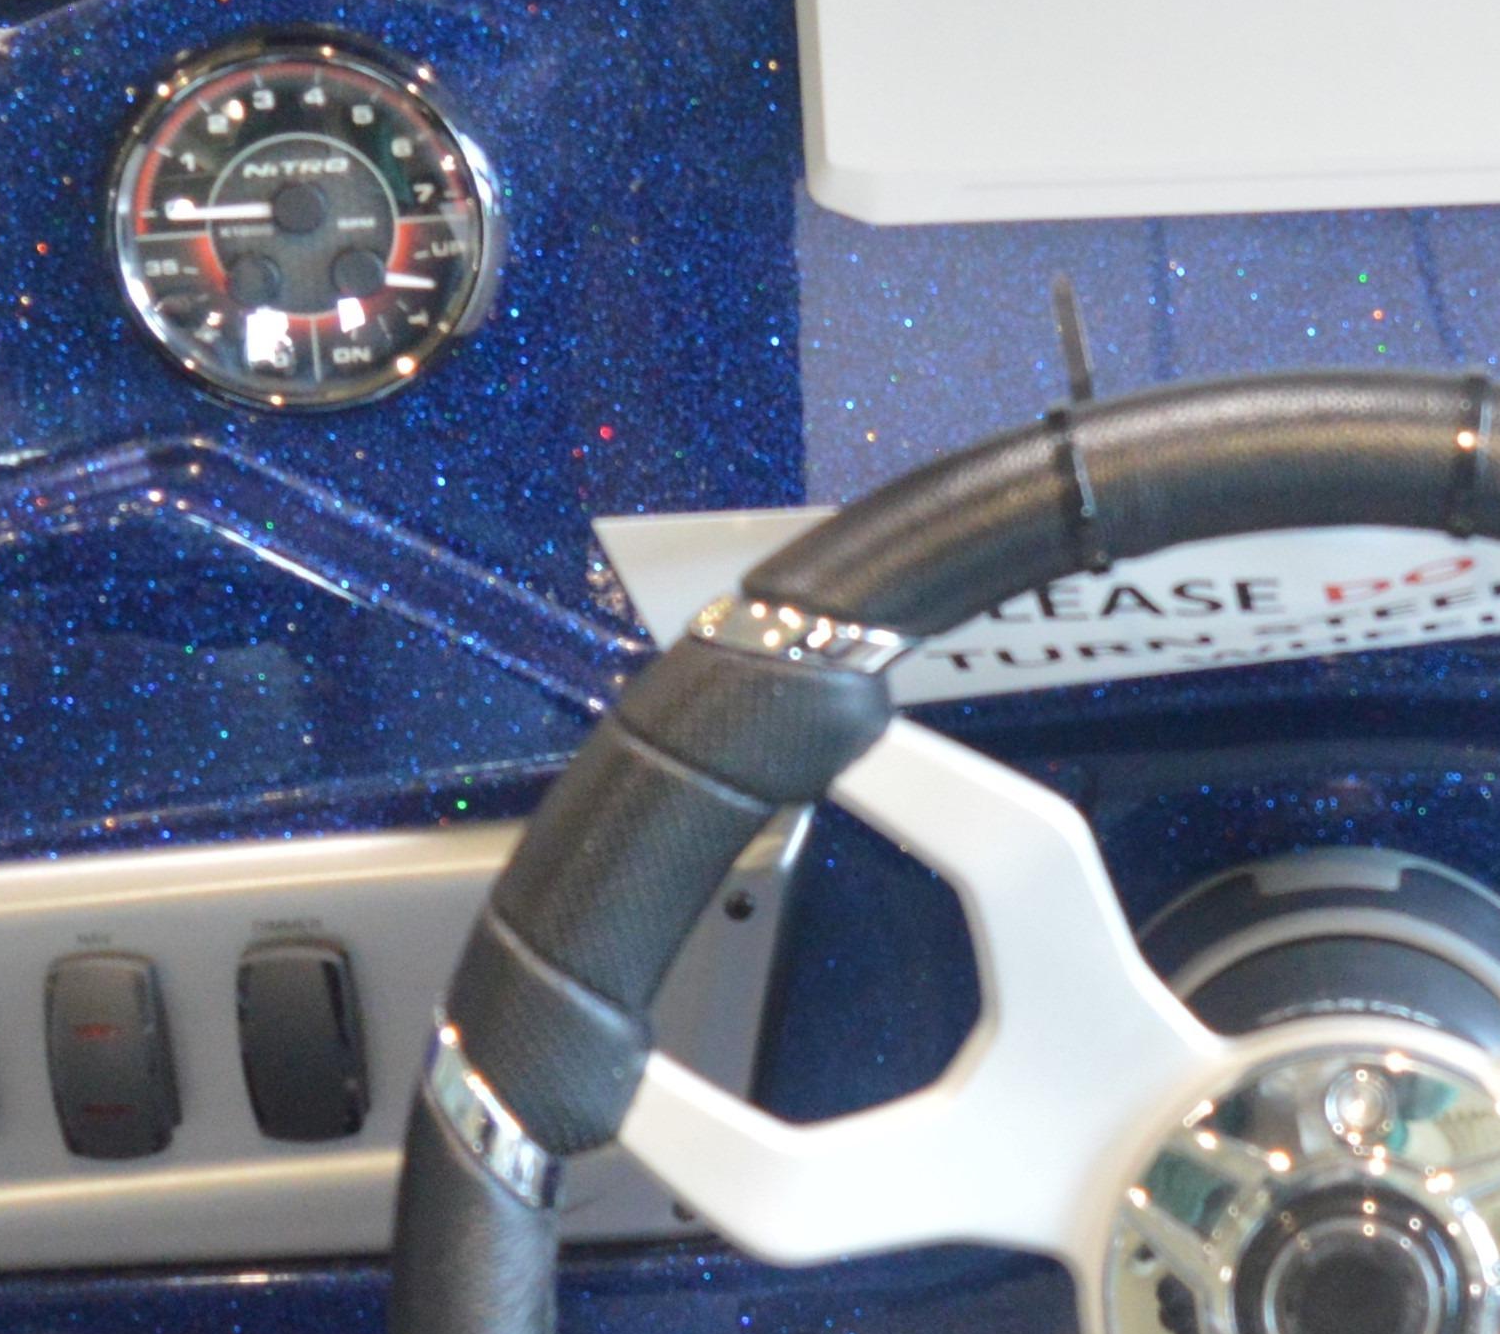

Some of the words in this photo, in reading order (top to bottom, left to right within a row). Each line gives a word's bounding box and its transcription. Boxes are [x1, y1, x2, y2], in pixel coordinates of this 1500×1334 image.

[251, 89, 275, 109] 3
[303, 87, 325, 105] 4
[207, 113, 229, 133] 2
[390, 137, 413, 157] 6
[180, 152, 196, 171] 1
[243, 156, 349, 178] NITRO
[413, 182, 434, 202] 7
[332, 348, 372, 364] DN
[984, 574, 1288, 622] LEASE
[925, 632, 1214, 673] TURN
